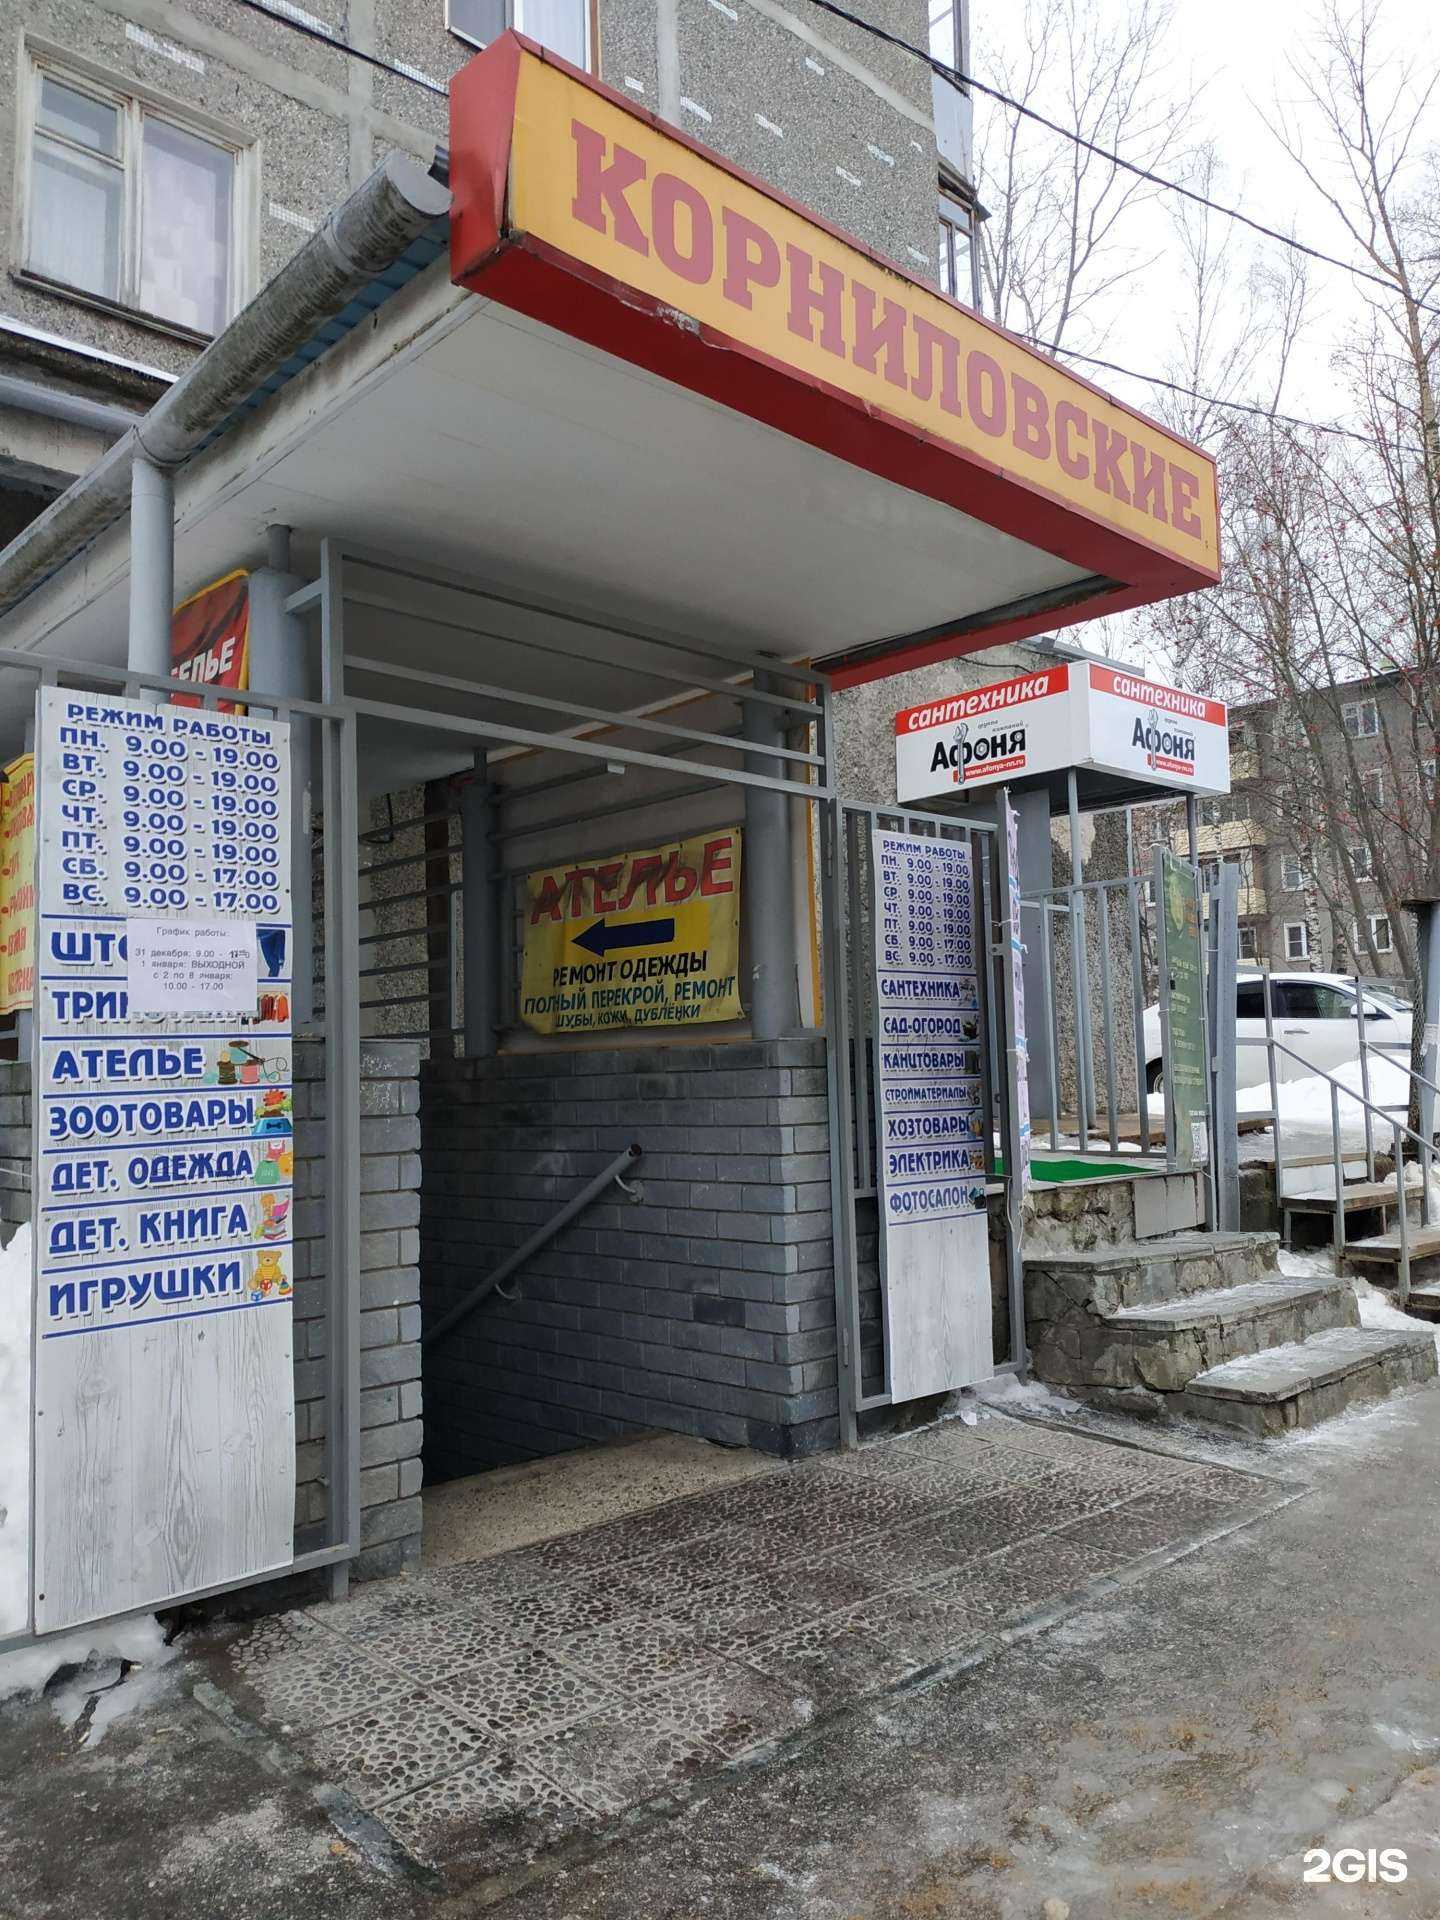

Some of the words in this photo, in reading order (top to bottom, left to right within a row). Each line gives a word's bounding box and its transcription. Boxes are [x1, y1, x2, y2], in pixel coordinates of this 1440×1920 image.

[570, 118, 1202, 539] КОРНИЛОВСКИЕ
[908, 675, 1049, 729] сантехника
[1113, 674, 1206, 719] сантехника
[67, 703, 164, 730] РЕЖИМ
[173, 719, 271, 745] РАБОТЫ
[60, 727, 106, 748] ПН.
[125, 736, 186, 758] 9.00
[214, 747, 278, 769] 19.00
[930, 729, 1025, 772] Афоня
[63, 754, 104, 773] ВТ.
[123, 761, 184, 781] 9.00
[211, 771, 276, 792] 19.00
[63, 780, 103, 798] СР.
[124, 786, 184, 806] 9.00
[212, 796, 276, 816] 19.00
[62, 806, 103, 824] ЧТ.
[124, 811, 184, 831] 9.00
[212, 820, 277, 839] 19.00
[63, 832, 104, 849] ПТ.
[124, 836, 184, 856] 9.00
[212, 844, 277, 863] 19.00
[883, 840, 921, 854] РЕЖИМ
[925, 846, 965, 859] РАБОТЫ
[63, 858, 104, 876] СБ.
[125, 862, 185, 880] 9.00
[214, 868, 277, 887] 17.00
[881, 855, 900, 866] ПН.
[907, 858, 931, 870] 9.00
[943, 862, 969, 875] 19.00
[531, 837, 733, 924] АТЕЛЬЕ
[884, 871, 900, 881] ВТ.
[907, 873, 931, 885] 9.00
[943, 878, 969, 890] 19.00
[63, 884, 104, 902] ВС.
[125, 887, 185, 906] 9.00
[214, 892, 278, 910] 17.00
[884, 887, 900, 898] СР.
[908, 889, 932, 901] 9.00
[943, 893, 969, 905] 19.00
[884, 903, 900, 913] ЧТ.
[908, 905, 932, 916] 9.00
[944, 909, 969, 920] 19.00
[156, 927, 190, 936] График
[885, 919, 900, 929] ПТ.
[909, 921, 932, 932] 9.00
[944, 924, 970, 935] 19.00
[135, 948, 145, 956] 31
[151, 949, 191, 958] декабря:
[885, 935, 901, 945] СБ.
[909, 937, 933, 948] 9.00
[944, 940, 970, 950] 17.00
[553, 961, 617, 986] РЕМОНТ
[621, 951, 707, 982] ОДЕЖДЫ
[885, 951, 902, 961] ВС.
[909, 953, 933, 963] 9.00
[945, 955, 971, 965] 17.00
[525, 986, 586, 1014] ПОЛНЫЙ
[674, 976, 735, 1001] РЕМОНТ
[882, 979, 960, 998] САНТЕХНИКА
[884, 1017, 960, 1034] САД-ОГОРОД
[53, 1048, 203, 1079] АТЕЛЬЕ
[884, 1052, 964, 1069] КАНЦТОВАРЫ
[886, 1087, 966, 1101] СТРОЙМАТЕРИАЛЫ
[50, 1098, 253, 1136] ЗООТОВАРЫ
[888, 1116, 968, 1137] ХОЗТОВАРЫ
[51, 1160, 117, 1191] ДЕТ.
[129, 1150, 253, 1185] ОДЕЖДА
[890, 1150, 968, 1174] ЭЛЕКТРИКА
[890, 1186, 968, 1212] ФОТОСАЛОН
[49, 1217, 126, 1254] ДЕТ.
[140, 1204, 247, 1244] КНИГА
[50, 1261, 240, 1316] ИГРУШКИ
